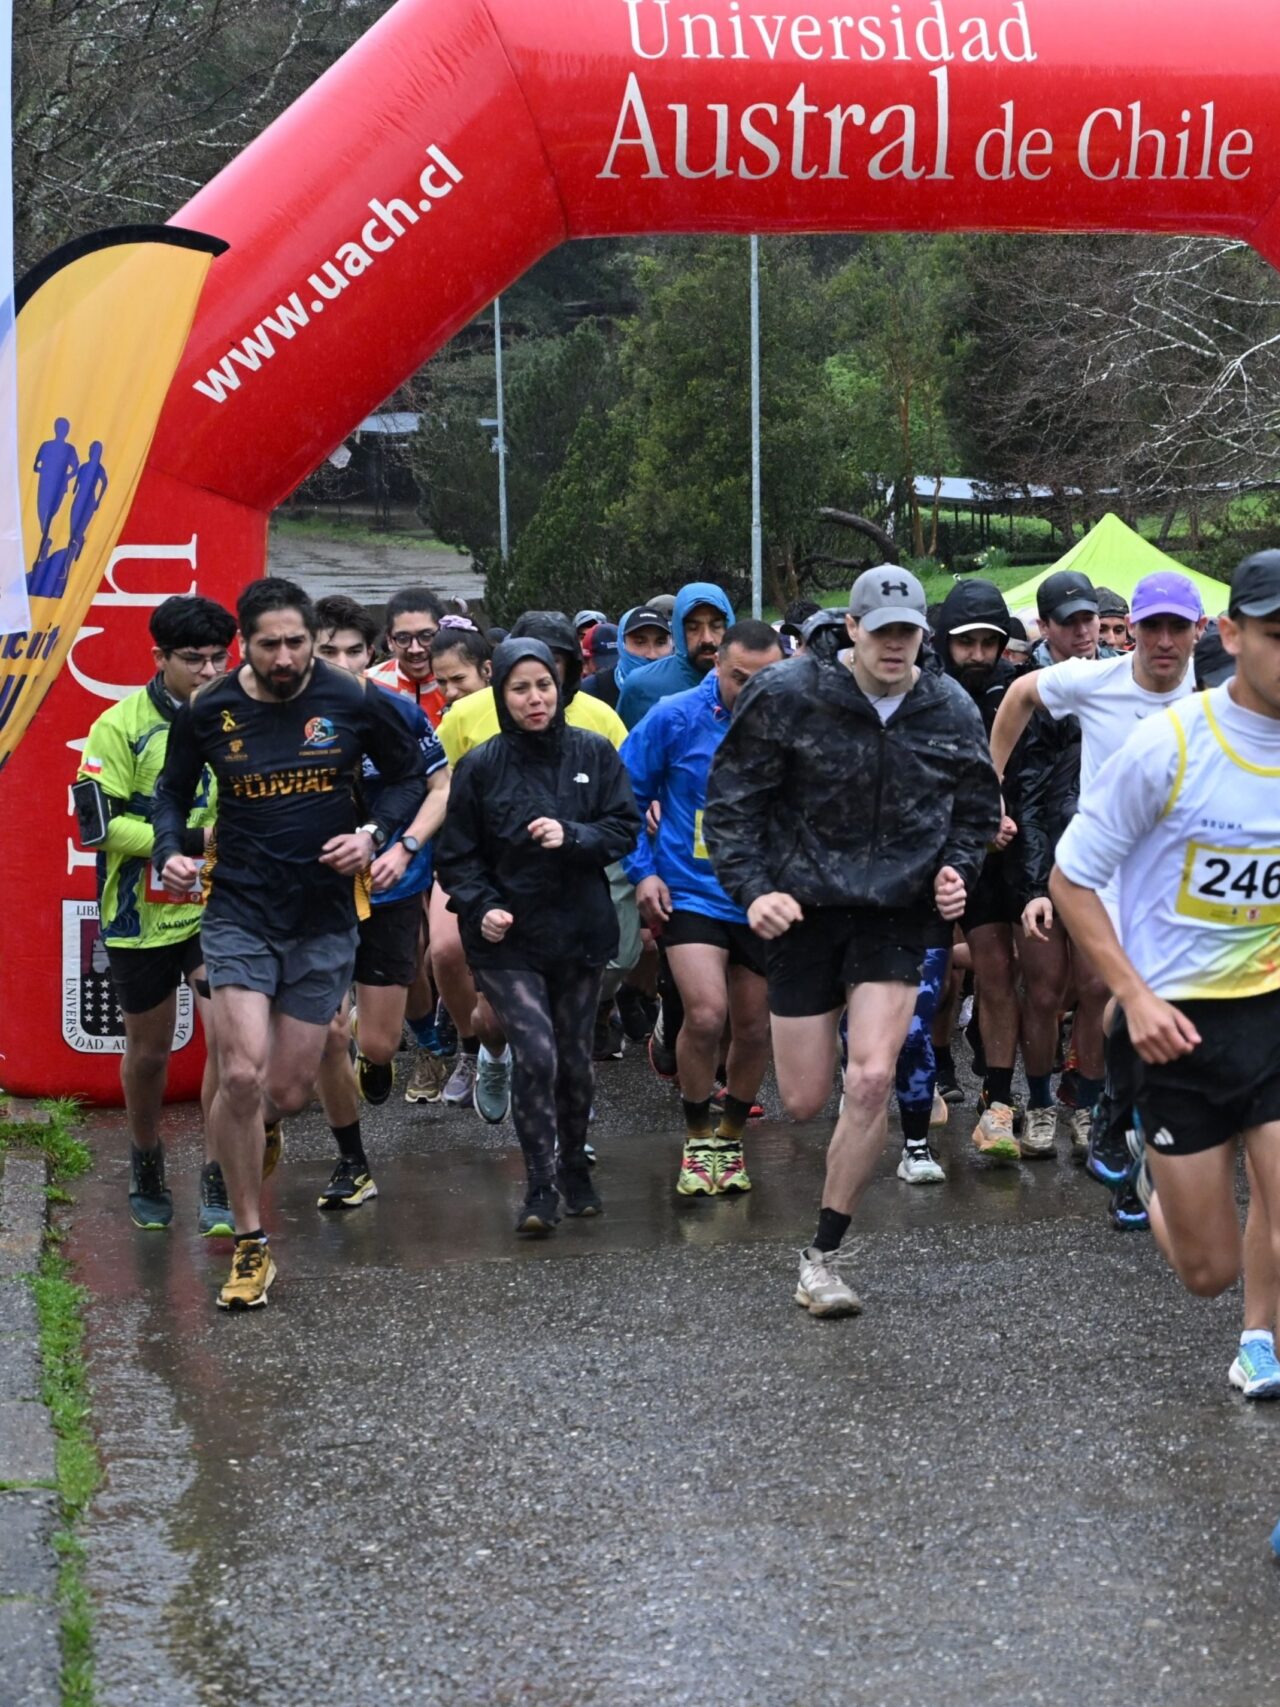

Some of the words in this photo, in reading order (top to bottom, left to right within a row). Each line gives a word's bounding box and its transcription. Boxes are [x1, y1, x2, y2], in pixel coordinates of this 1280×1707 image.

[622, 0, 1038, 62] Universidad
[595, 65, 954, 180] Austral
[975, 100, 1053, 180] de
[1078, 100, 1253, 180] Chile
[192, 143, 464, 404] www.uach.cl
[233, 777, 334, 799] FLUVIAL
[66, 978, 104, 1050] UNIVERSIDAD
[175, 1022, 189, 1041] DE
